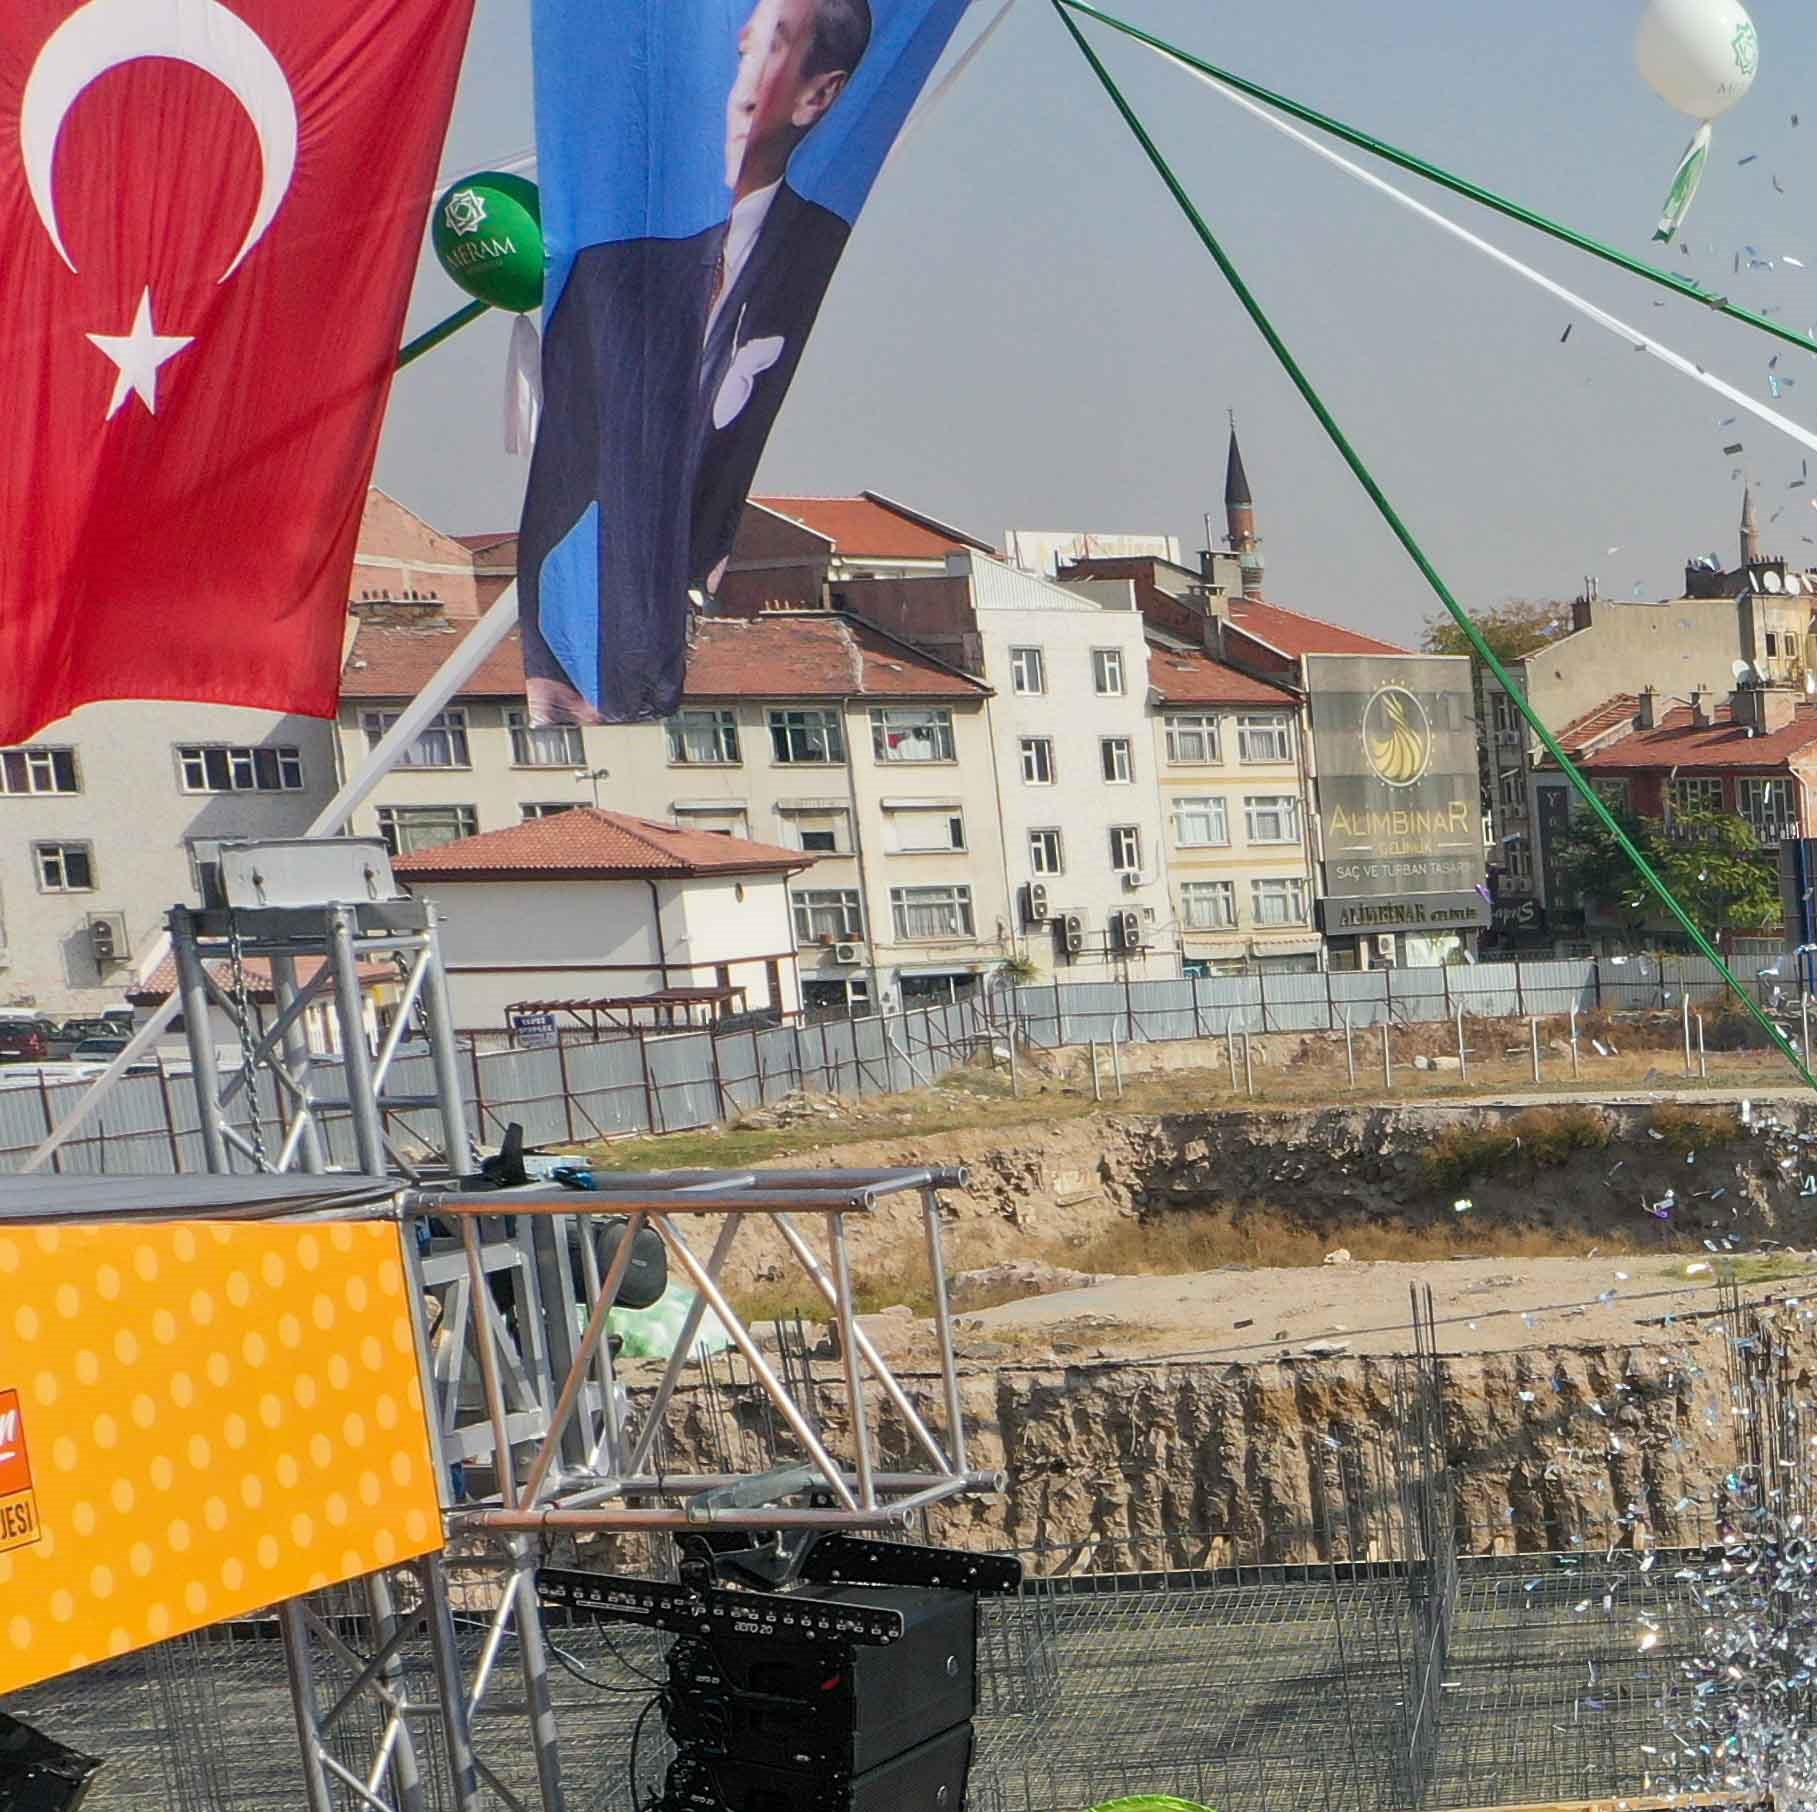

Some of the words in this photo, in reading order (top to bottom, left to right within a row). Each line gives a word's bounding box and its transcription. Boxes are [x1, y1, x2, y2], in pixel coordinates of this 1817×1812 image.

[447, 236, 517, 269] MERAM
[1336, 865, 1361, 881] SAÇ
[1364, 863, 1378, 878] VE
